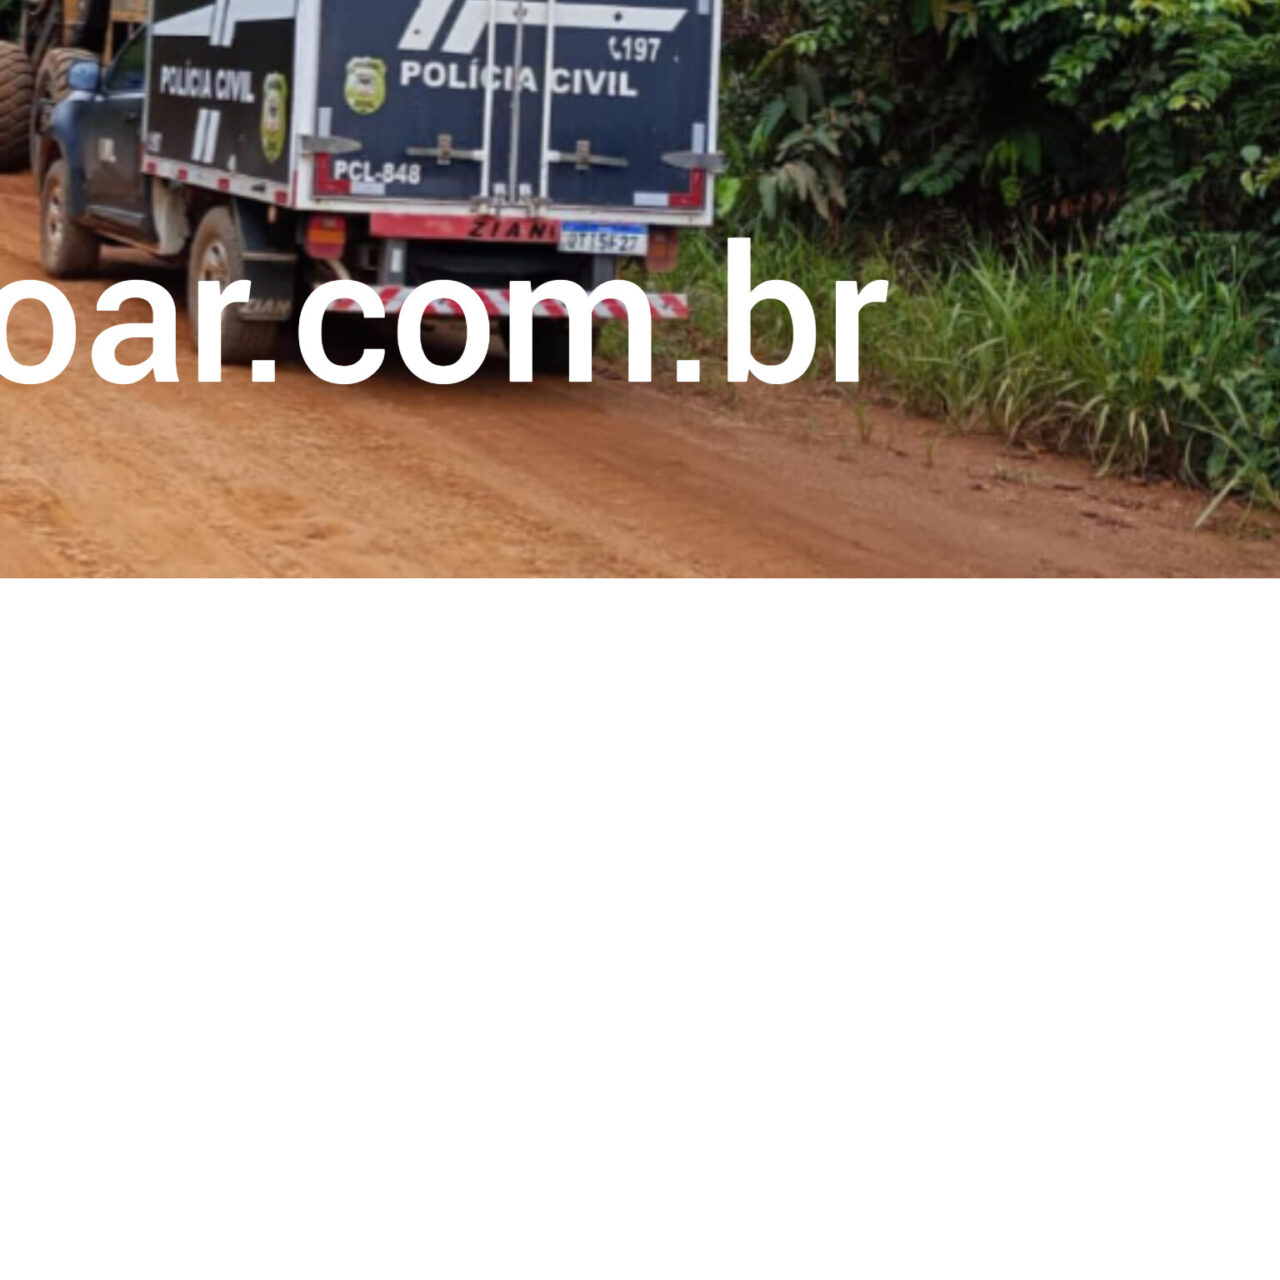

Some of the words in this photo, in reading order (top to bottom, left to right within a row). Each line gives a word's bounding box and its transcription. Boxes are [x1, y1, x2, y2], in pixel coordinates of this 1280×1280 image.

[621, 37, 661, 62] 197
[160, 59, 211, 98] POLÍCIA
[215, 69, 256, 103] CIVIL
[400, 58, 538, 92] POLÍCIA
[549, 68, 638, 97] CIVIL
[333, 160, 420, 185] PCL-848
